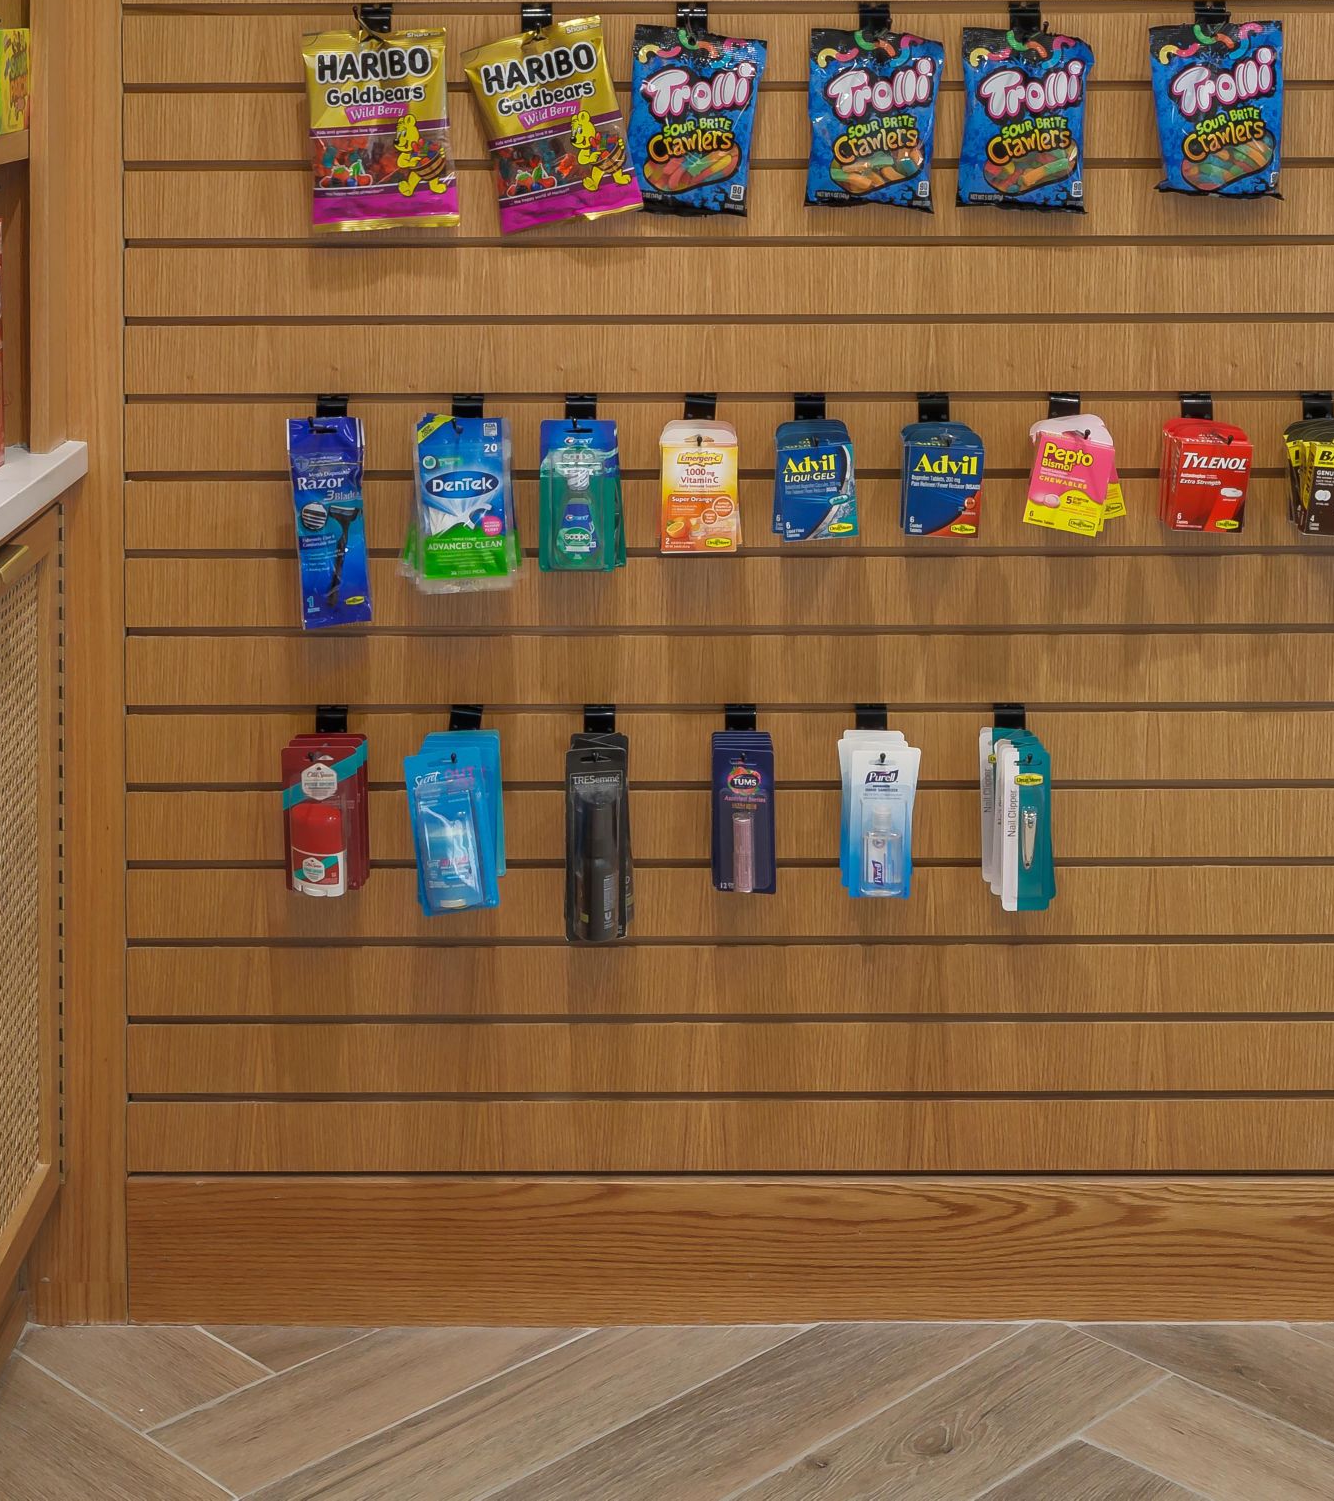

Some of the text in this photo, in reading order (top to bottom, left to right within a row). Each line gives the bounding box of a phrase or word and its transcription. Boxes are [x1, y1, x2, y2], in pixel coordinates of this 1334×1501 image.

[316, 47, 432, 84] HARIBO
[481, 41, 597, 96] HARIBO
[326, 85, 425, 106] Goldbears
[645, 61, 756, 118] Trolli
[826, 57, 935, 119] Trolli
[497, 80, 594, 116] Goldbears
[350, 104, 404, 120] Wild Berry
[523, 101, 578, 127] Wild Berry
[647, 128, 734, 163] Crawlers
[483, 443, 498, 453] 20
[1043, 442, 1094, 468] Pepto
[680, 454, 721, 466] Emergen-C
[782, 453, 836, 475] Advil
[913, 453, 978, 476] Advil
[1041, 457, 1074, 472] Bismol
[1182, 452, 1247, 471] TYLENOL
[297, 475, 345, 491] Razor
[431, 475, 494, 493] DenTek
[681, 476, 719, 485] Vitamin C
[1038, 474, 1089, 490] CHEWABLES
[1179, 478, 1222, 487] Extra Strength
[671, 495, 690, 504] Super
[427, 539, 503, 551] ADVANCED CLEAN
[564, 532, 591, 543] scope
[414, 770, 441, 788] Secret
[732, 778, 757, 787] TUMS
[867, 771, 897, 784] Purell
[983, 767, 993, 814] Nail Clipper
[1007, 788, 1019, 838] Nail Clipper
